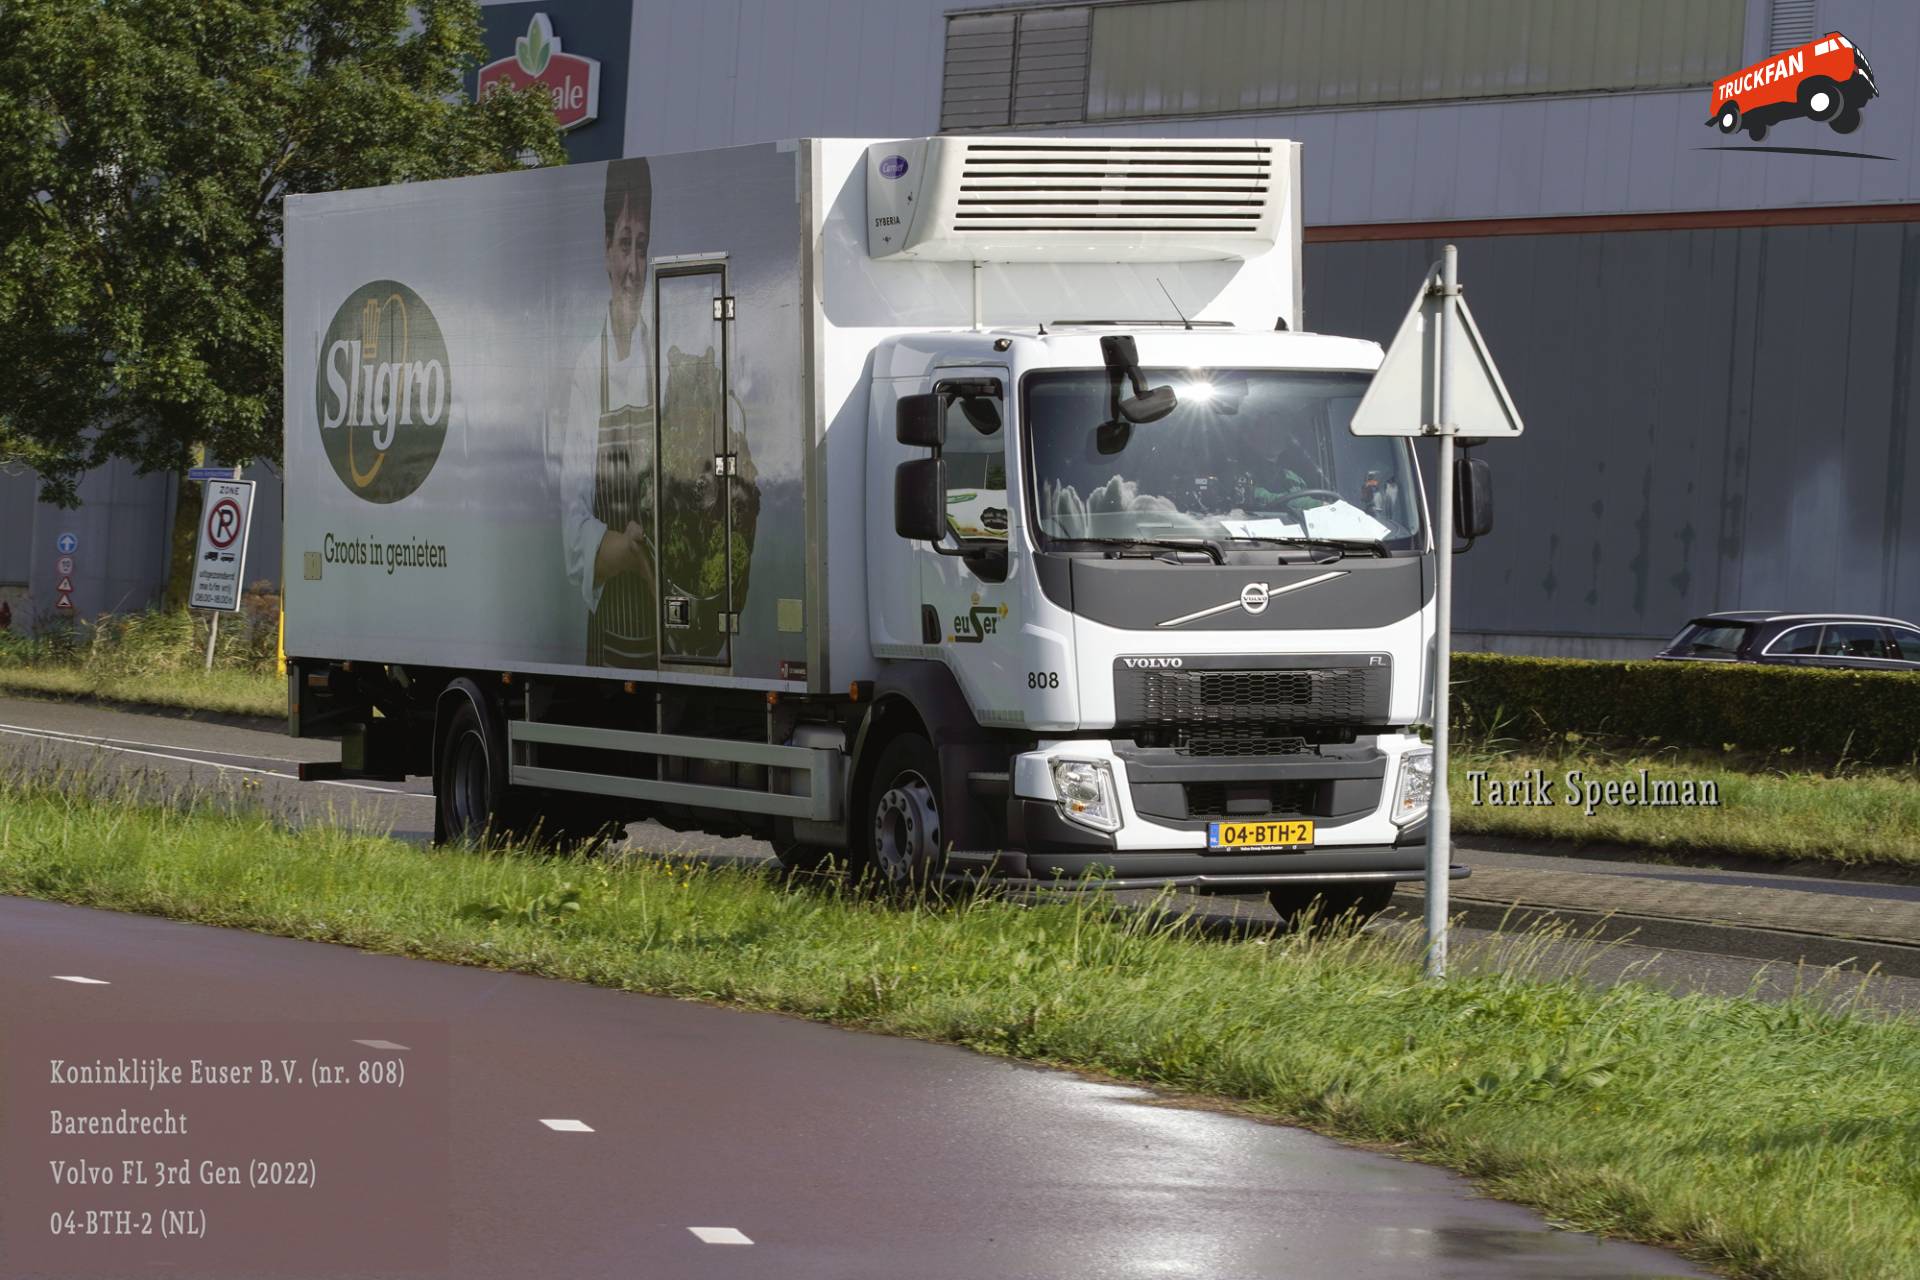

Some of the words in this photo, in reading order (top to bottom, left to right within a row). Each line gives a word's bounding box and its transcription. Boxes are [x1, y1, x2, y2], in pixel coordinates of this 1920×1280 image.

[875, 216, 901, 228] SYBERIA
[323, 340, 446, 450] Sligro
[219, 485, 240, 495] ZONE
[324, 533, 367, 565] Groots
[370, 535, 384, 566] in
[386, 536, 447, 575] genieten
[1123, 657, 1183, 668] VOLVO
[1369, 656, 1386, 667] FL
[1028, 671, 1059, 689] 808
[1224, 824, 1307, 844] 04-BTH-2
